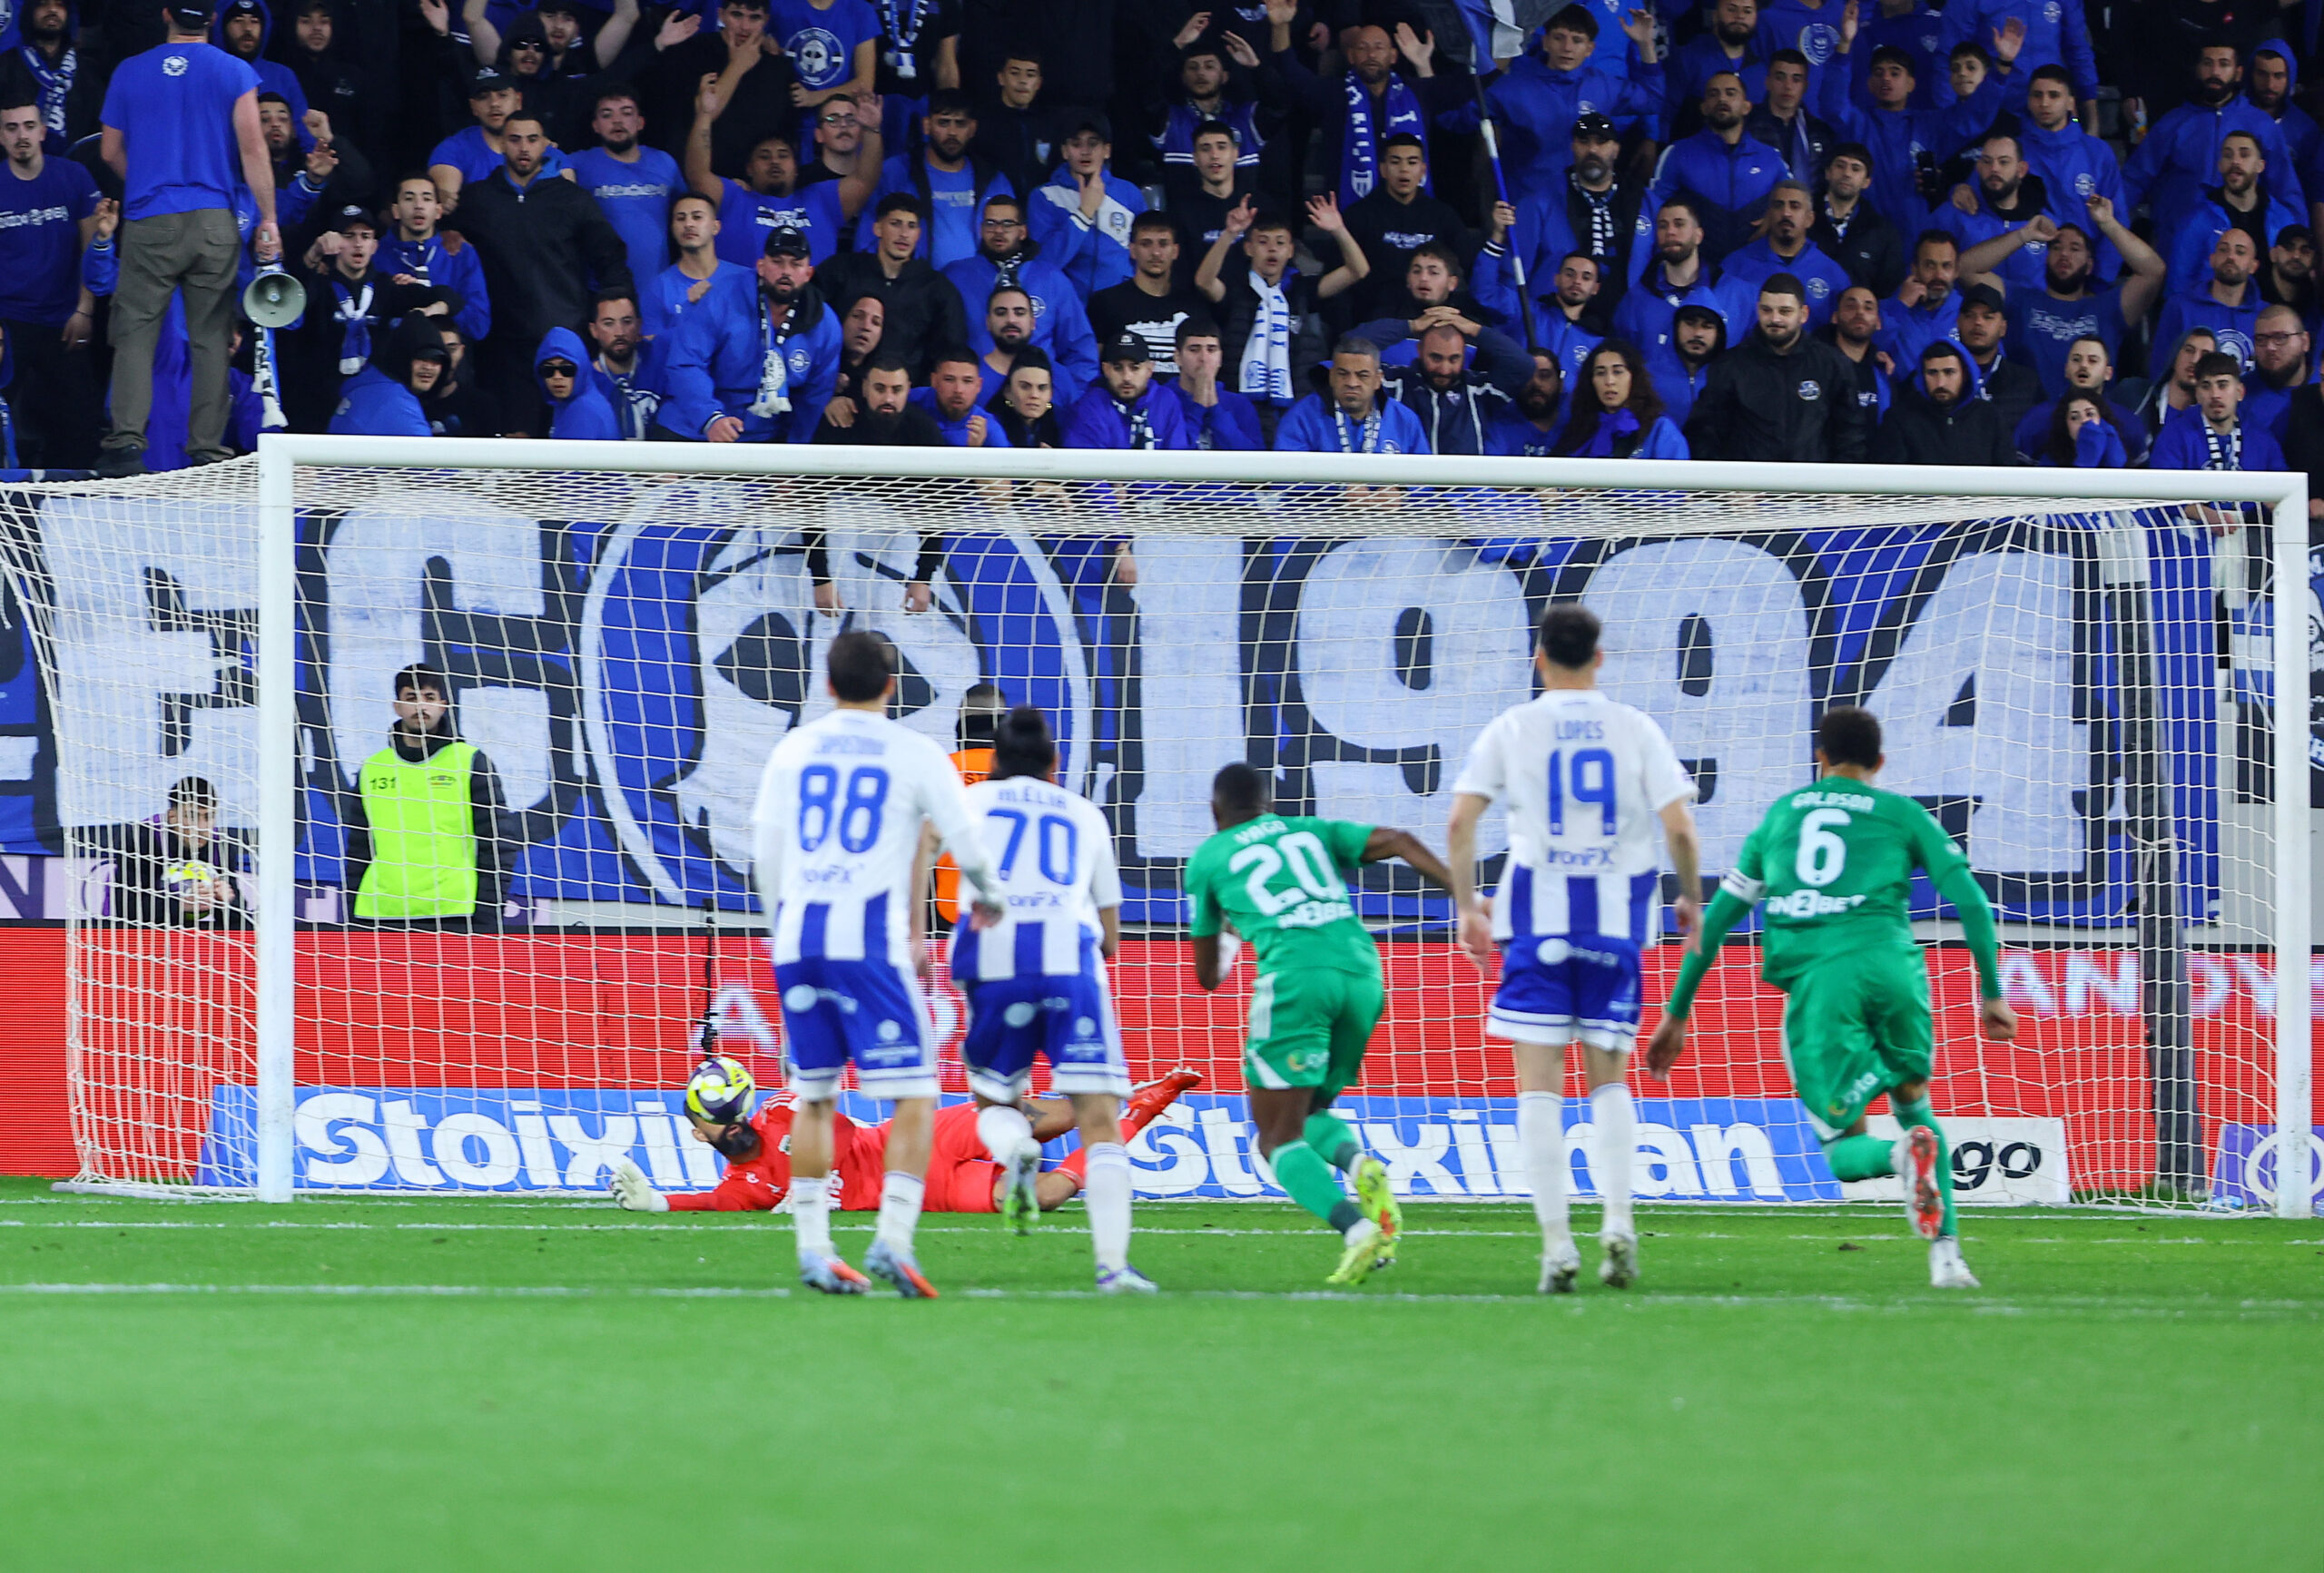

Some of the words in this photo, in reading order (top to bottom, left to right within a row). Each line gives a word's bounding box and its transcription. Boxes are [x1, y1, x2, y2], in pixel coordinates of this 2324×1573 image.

[1135, 534, 2086, 873] 1994
[1555, 720, 1604, 741] LOPES
[369, 776, 397, 791] 131
[799, 763, 891, 854] 88
[1549, 746, 1617, 836] 19
[1791, 791, 1876, 813] GOLDSON
[987, 808, 1077, 886] 70
[1228, 831, 1344, 917] 20
[1796, 807, 1852, 888] 6
[1950, 1141, 2043, 1192] go
